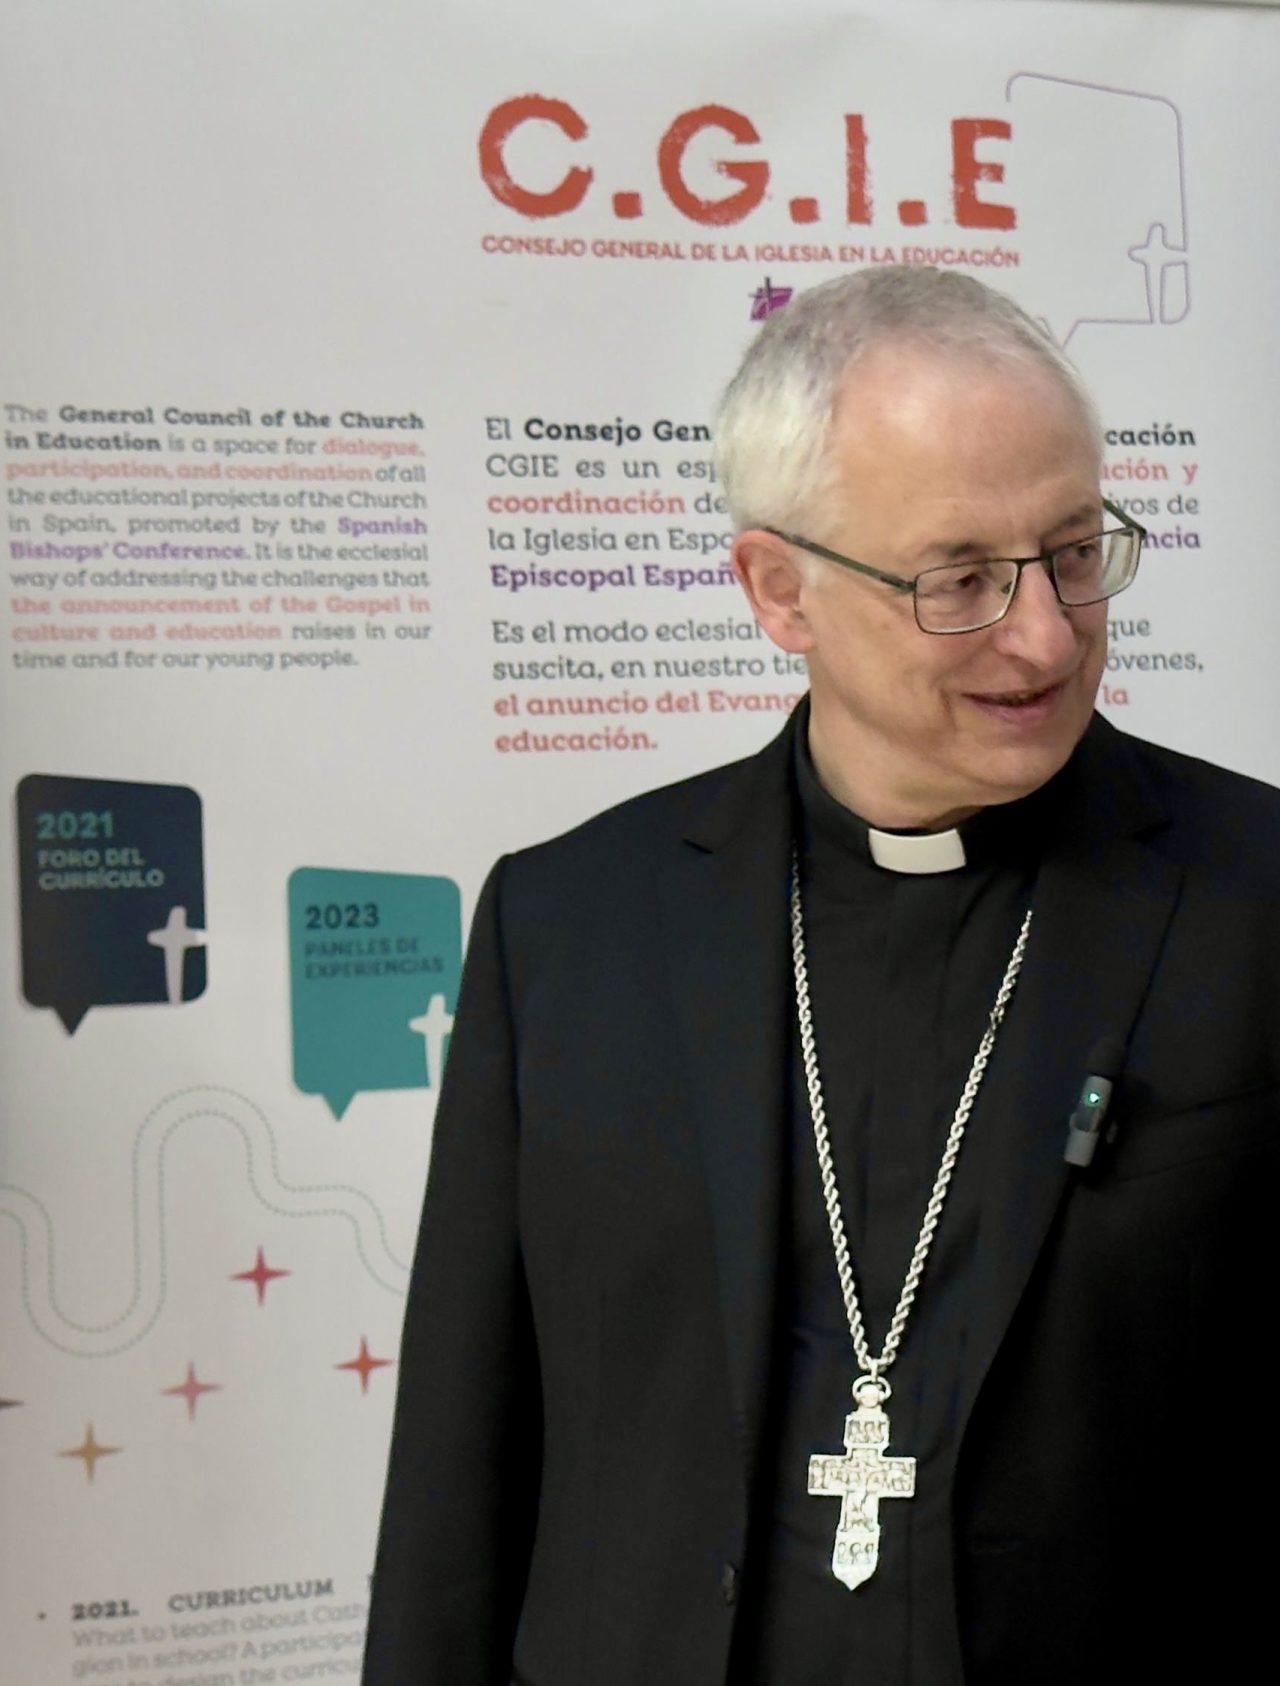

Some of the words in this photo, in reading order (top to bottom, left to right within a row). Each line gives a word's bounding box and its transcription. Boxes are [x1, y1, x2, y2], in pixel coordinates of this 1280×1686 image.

[478, 94, 1018, 232] C.G.I.E
[481, 234, 587, 258] CONSEJO
[591, 237, 687, 261] GENERAL
[691, 241, 715, 262] DE
[721, 241, 749, 263] LA
[754, 242, 831, 264] IGLESIA
[839, 246, 865, 265] EN
[870, 247, 896, 266] LA
[902, 245, 1020, 269] EDUCACIÓN
[4, 402, 48, 423] The
[59, 404, 154, 424] General
[163, 407, 252, 426] Council
[260, 409, 285, 427] of
[293, 410, 330, 428] the
[340, 411, 425, 430] Church
[4, 430, 29, 449] in
[36, 432, 162, 450] Education
[167, 433, 185, 451] is
[191, 438, 207, 452] a
[213, 438, 279, 456] space
[285, 437, 317, 454] for
[485, 418, 512, 441] El
[524, 418, 642, 446] Consejo
[1104, 423, 1197, 446] cación
[177, 463, 220, 480] and
[225, 463, 373, 481] coordination
[375, 465, 399, 483] of
[400, 466, 426, 483] all
[486, 454, 560, 478] CGIE
[575, 460, 606, 478] es
[623, 460, 661, 479] un
[1182, 463, 1198, 486] y
[7, 488, 46, 505] the
[50, 488, 188, 506] educational
[192, 488, 281, 510] projects
[283, 490, 307, 508] of
[308, 490, 344, 508] the
[347, 490, 427, 510] Church
[487, 490, 686, 514] coordinación
[694, 492, 728, 514] de
[1167, 495, 1199, 515] de
[8, 514, 31, 533] in
[128, 516, 240, 536] promoted
[252, 516, 280, 538] by
[290, 517, 326, 535] the
[338, 516, 428, 538] Spanish
[112, 541, 251, 561] Conference.
[254, 543, 272, 561] It
[276, 543, 293, 561] is
[298, 543, 333, 561] the
[337, 543, 429, 562] ecclesial
[488, 529, 516, 551] la
[523, 527, 618, 555] Iglesia
[625, 533, 660, 550] en
[9, 571, 58, 591] way
[62, 569, 87, 588] of
[90, 568, 217, 591] addressing
[221, 569, 257, 588] the
[261, 568, 378, 591] challenges
[382, 570, 430, 588] that
[490, 563, 636, 592] Episcopal
[643, 561, 735, 592] Españ
[9, 597, 51, 614] the
[59, 598, 240, 614] announcement
[249, 596, 273, 614] of
[280, 596, 317, 614] the
[325, 595, 401, 617] Gospel
[409, 595, 431, 613] in
[11, 624, 100, 642] culture
[109, 623, 157, 641] and
[165, 622, 282, 641] education
[291, 622, 356, 640] raises
[365, 621, 386, 640] in
[394, 624, 432, 641] our
[492, 621, 525, 643] Es
[532, 621, 557, 642] el
[564, 621, 649, 643] modo
[656, 617, 763, 643] eclesial
[12, 652, 66, 669] time
[71, 651, 118, 669] and
[124, 650, 157, 669] for
[161, 654, 200, 669] our
[205, 653, 275, 671] young
[279, 650, 359, 671] people.
[493, 656, 603, 680] suscita,
[611, 664, 646, 679] en
[655, 656, 766, 678] nuestro
[494, 694, 519, 716] el
[526, 692, 649, 714] anuncio
[656, 692, 701, 713] del
[1102, 684, 1129, 706] la
[495, 728, 658, 753] educación.
[37, 810, 114, 839] 2021
[38, 848, 100, 868] FORO
[104, 847, 145, 866] DEL
[39, 865, 165, 890] CURRÍCULO
[305, 902, 379, 930] 2023
[305, 937, 390, 957] PANELES
[396, 937, 418, 953] DE
[305, 956, 444, 979] EXPERIENCIAS
[72, 1599, 138, 1621] 2021.
[168, 1578, 334, 1612] CURRICULUM
